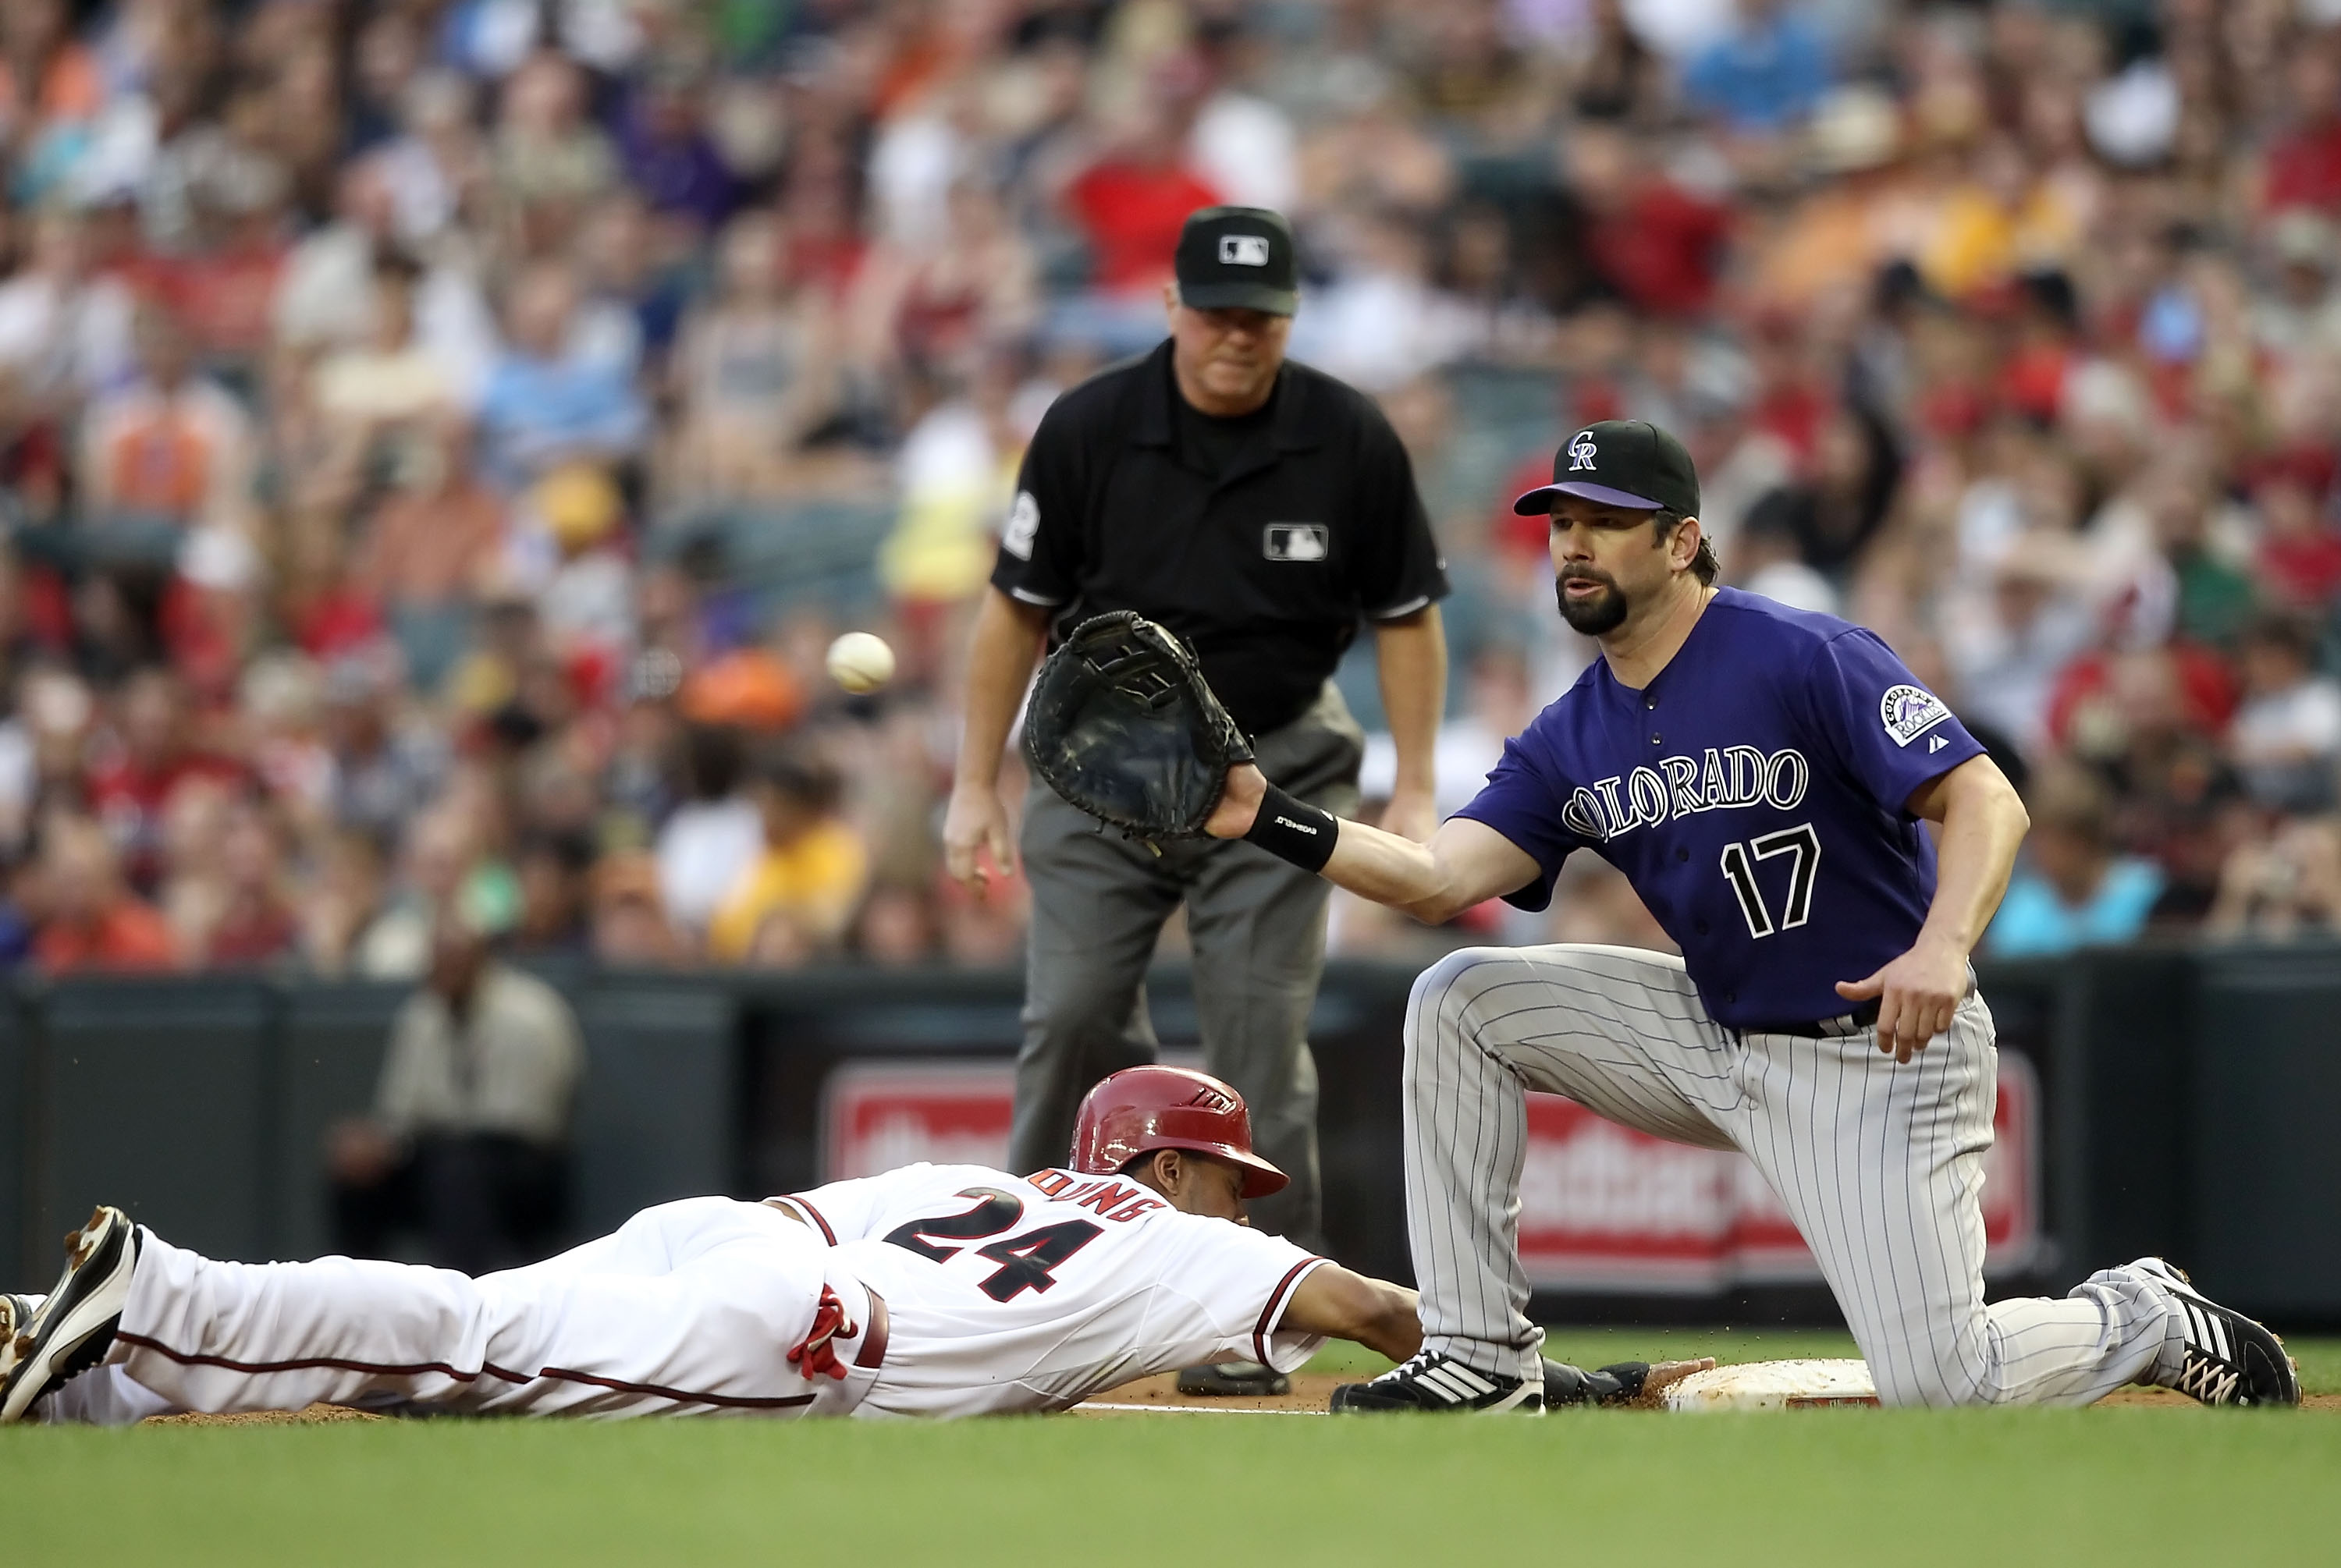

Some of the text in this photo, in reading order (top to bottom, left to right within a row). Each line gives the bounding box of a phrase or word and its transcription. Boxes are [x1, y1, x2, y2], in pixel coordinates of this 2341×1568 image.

[1720, 822, 1821, 939] 17
[883, 1187, 1104, 1304] 24
[1027, 1168, 1167, 1222] OUNG
